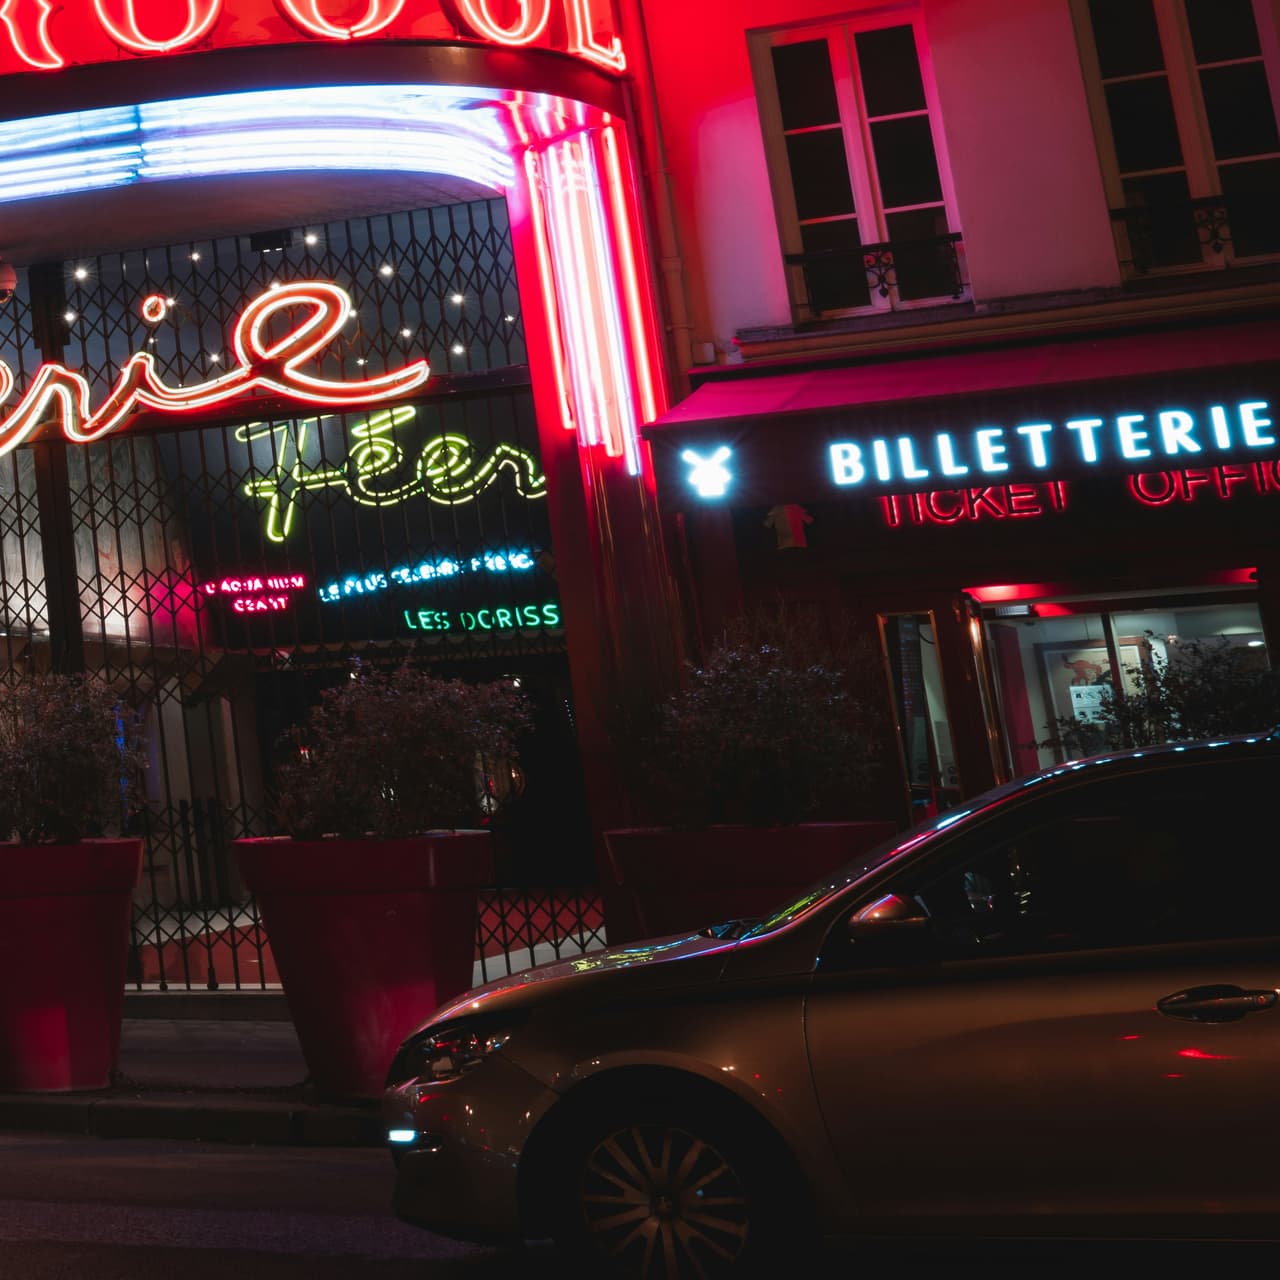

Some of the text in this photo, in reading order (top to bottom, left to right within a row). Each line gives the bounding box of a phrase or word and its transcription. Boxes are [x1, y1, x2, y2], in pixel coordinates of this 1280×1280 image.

[829, 401, 1276, 486] BILLETTERIE
[878, 480, 1070, 527] TICKET
[404, 609, 450, 631] LES
